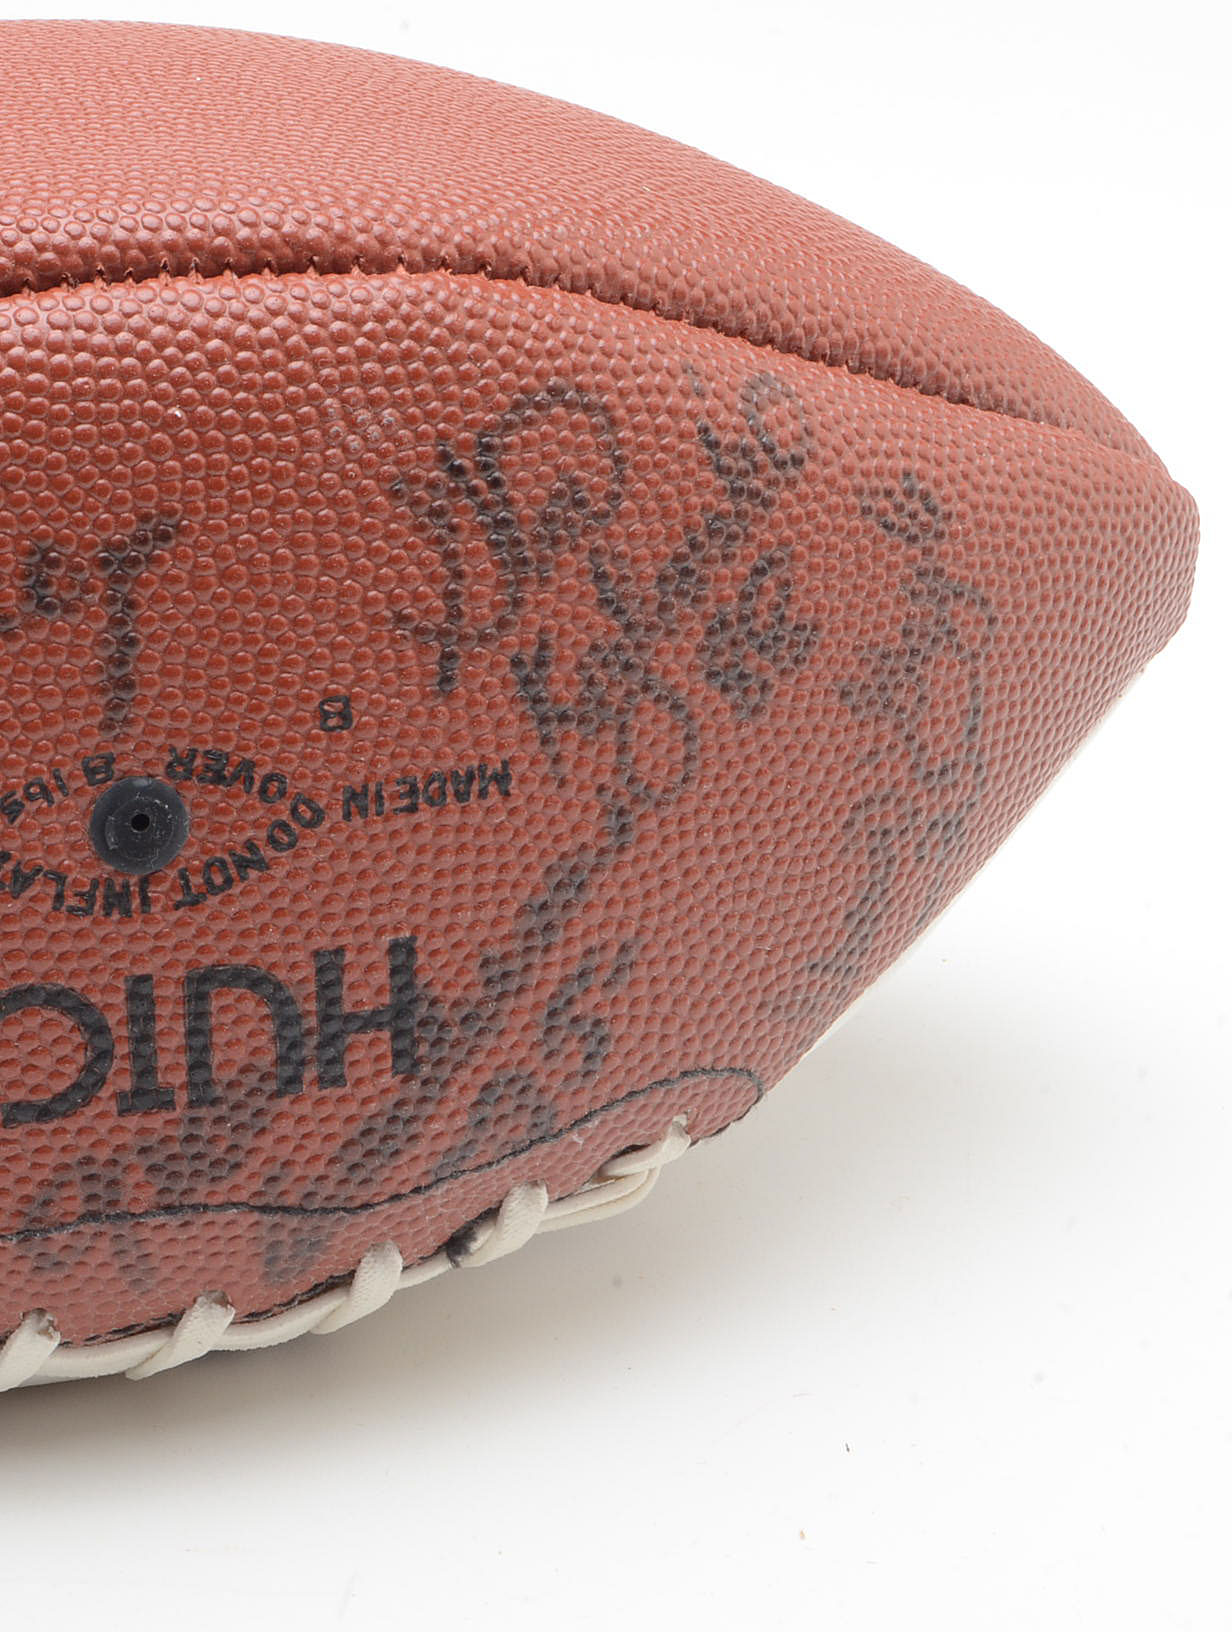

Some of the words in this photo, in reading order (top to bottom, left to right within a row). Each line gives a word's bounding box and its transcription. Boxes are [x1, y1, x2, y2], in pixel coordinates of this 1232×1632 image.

[166, 746, 288, 804] OVER
[342, 781, 385, 821] IN
[393, 759, 513, 815] MADE
[267, 792, 326, 852] DO
[172, 840, 269, 910] NOT
